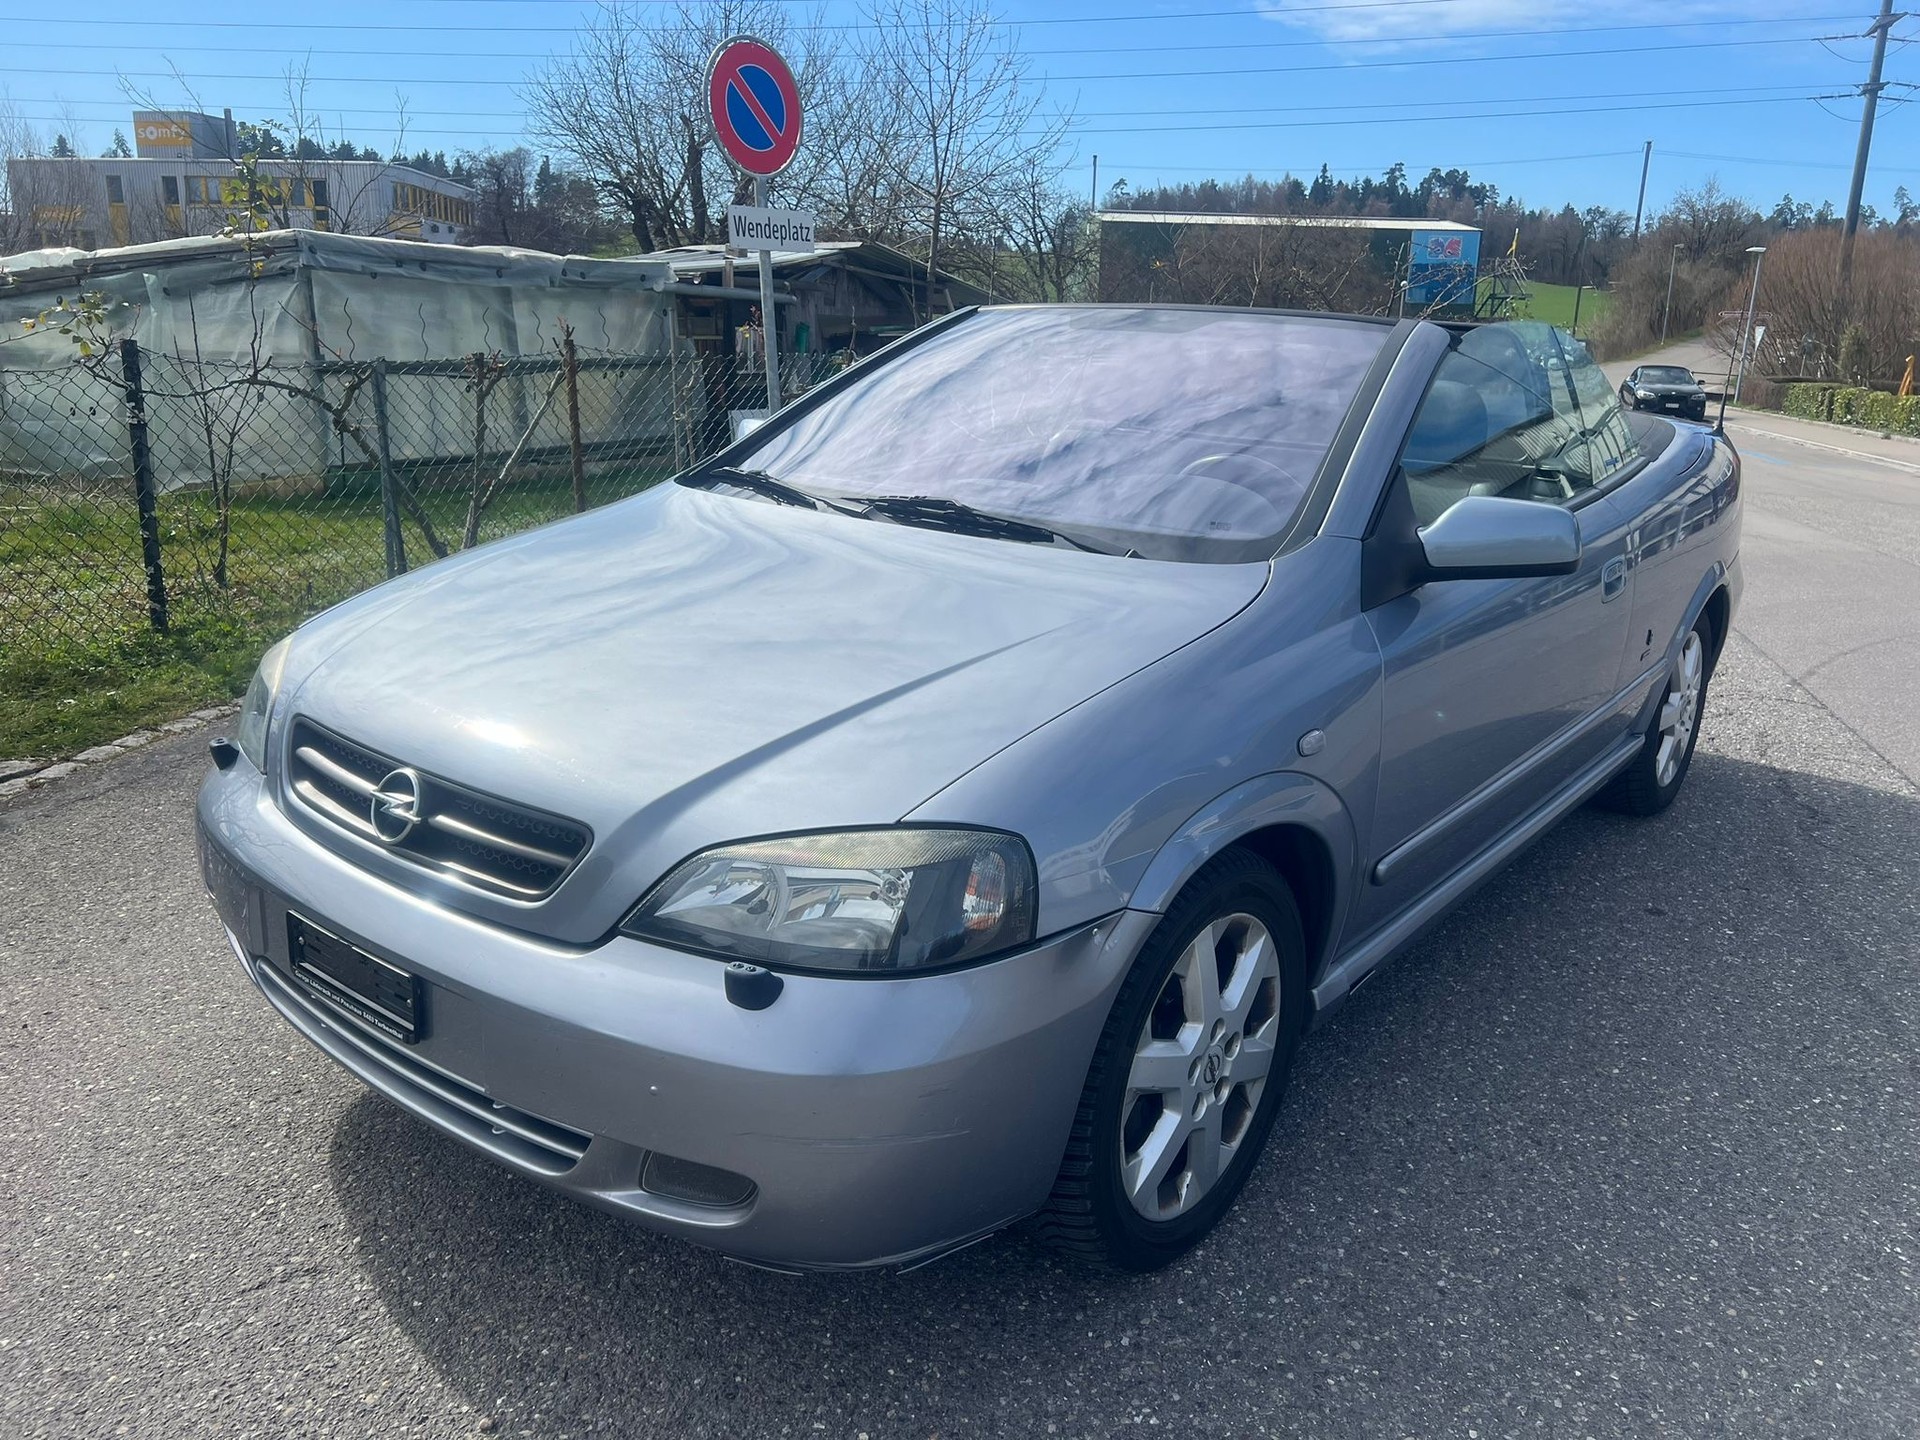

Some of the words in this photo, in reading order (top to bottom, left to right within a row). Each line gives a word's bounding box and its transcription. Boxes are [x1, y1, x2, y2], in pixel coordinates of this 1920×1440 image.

[137, 124, 186, 141] somfy
[733, 214, 811, 247] Wendeplatz
[295, 970, 309, 982] Garage
[331, 993, 340, 1002] und
[374, 1018, 403, 1040] Turbenthal
